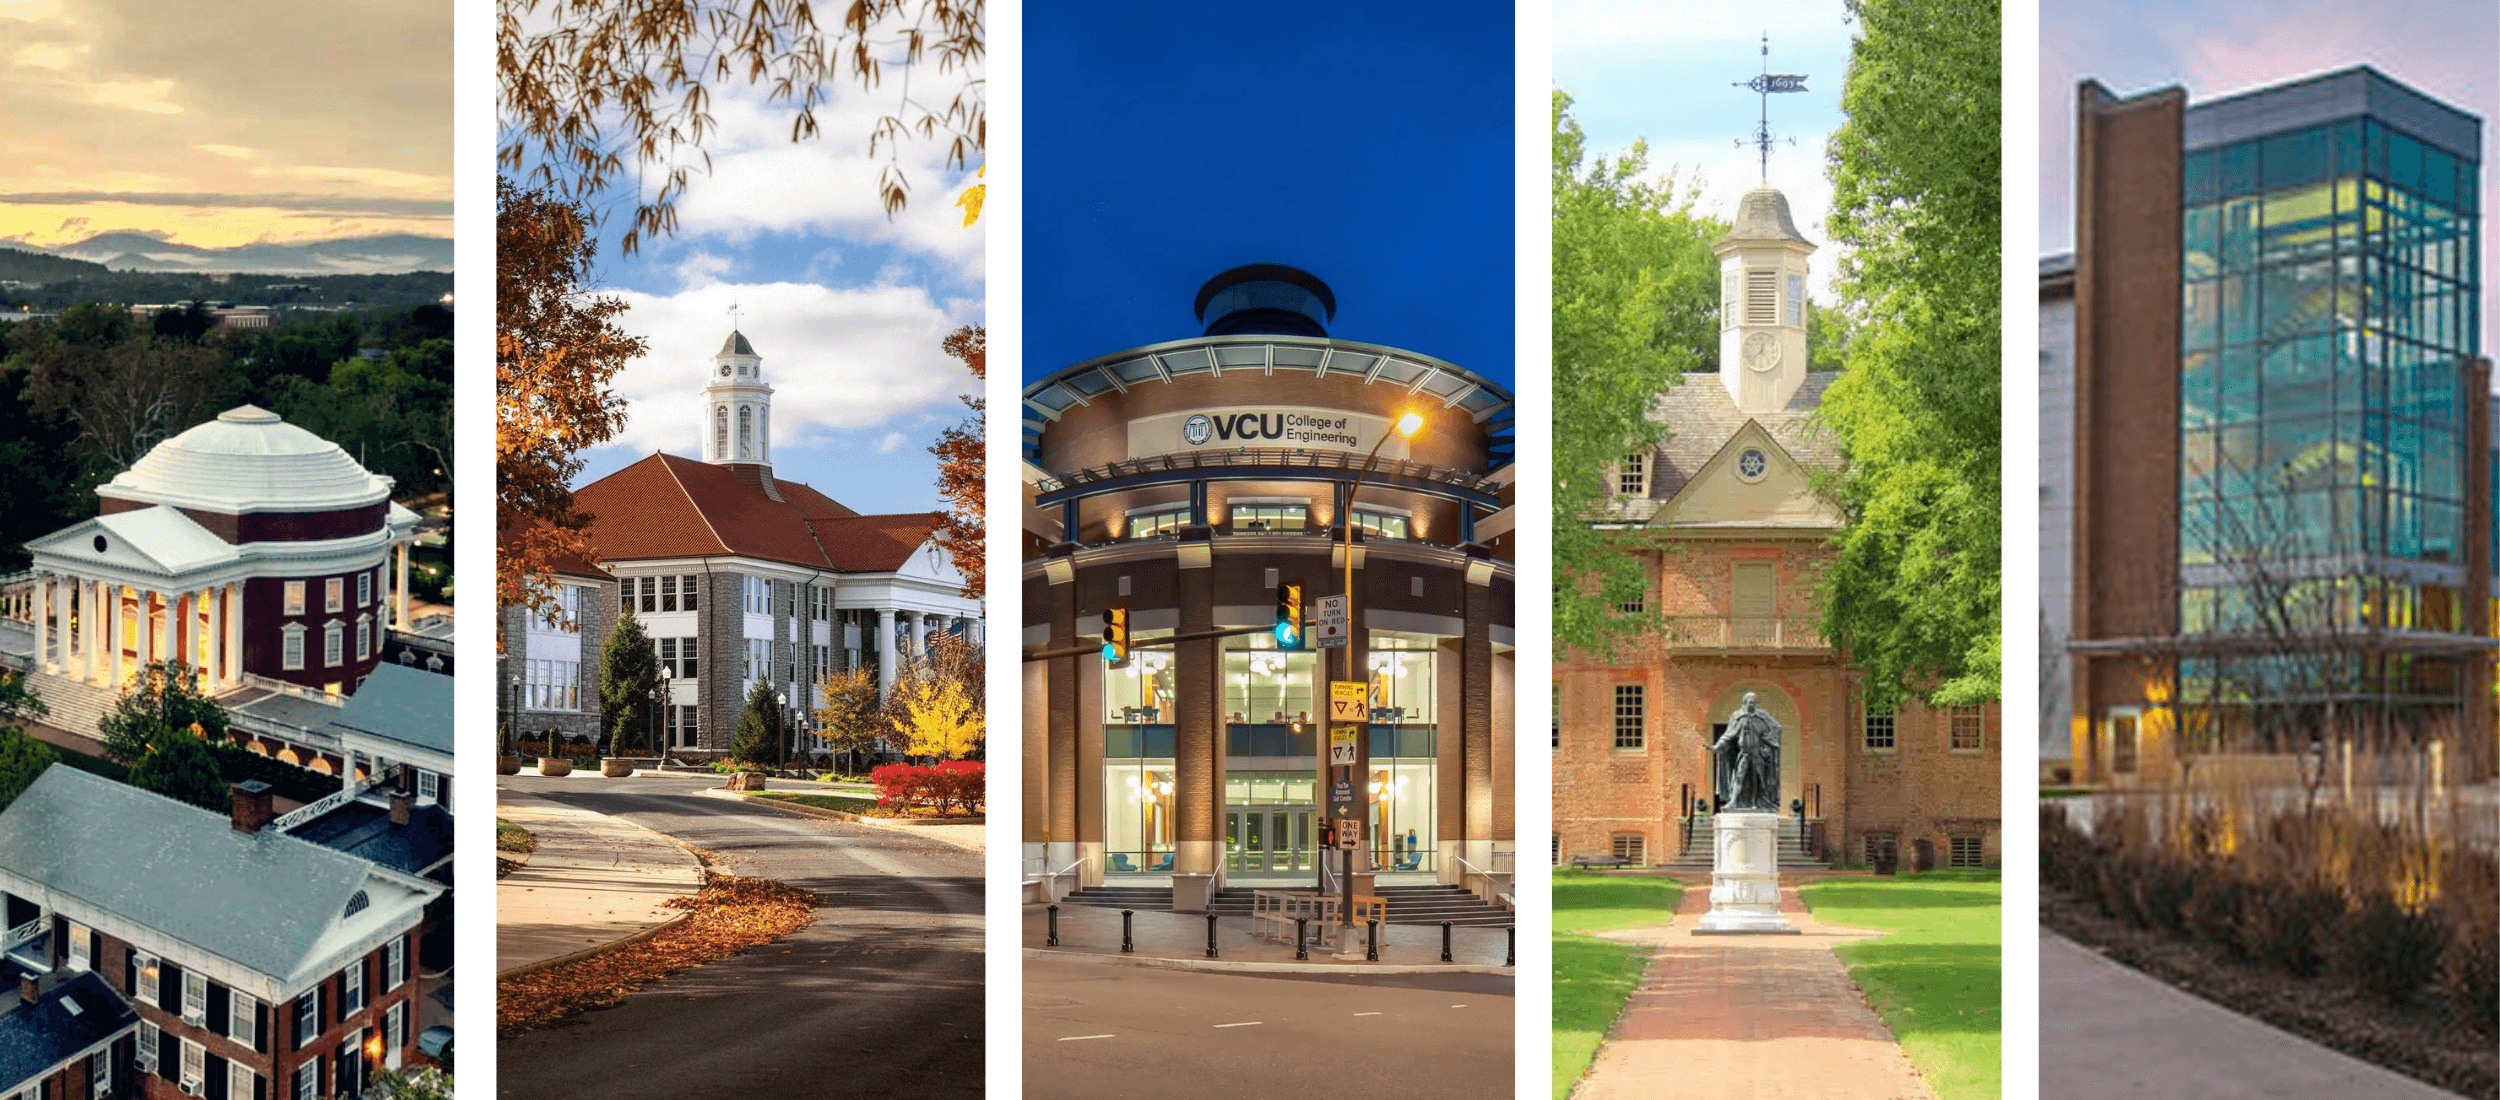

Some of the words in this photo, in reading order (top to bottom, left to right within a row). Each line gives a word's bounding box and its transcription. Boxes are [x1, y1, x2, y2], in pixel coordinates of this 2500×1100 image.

[1212, 413, 1283, 440] VCU
[1286, 414, 1331, 430] College
[1334, 418, 1347, 429] of
[1286, 428, 1357, 447] Engineering
[1325, 600, 1338, 609] NO
[1323, 609, 1341, 617] TURN
[1331, 617, 1345, 625] RED
[1342, 821, 1358, 829] ONE
